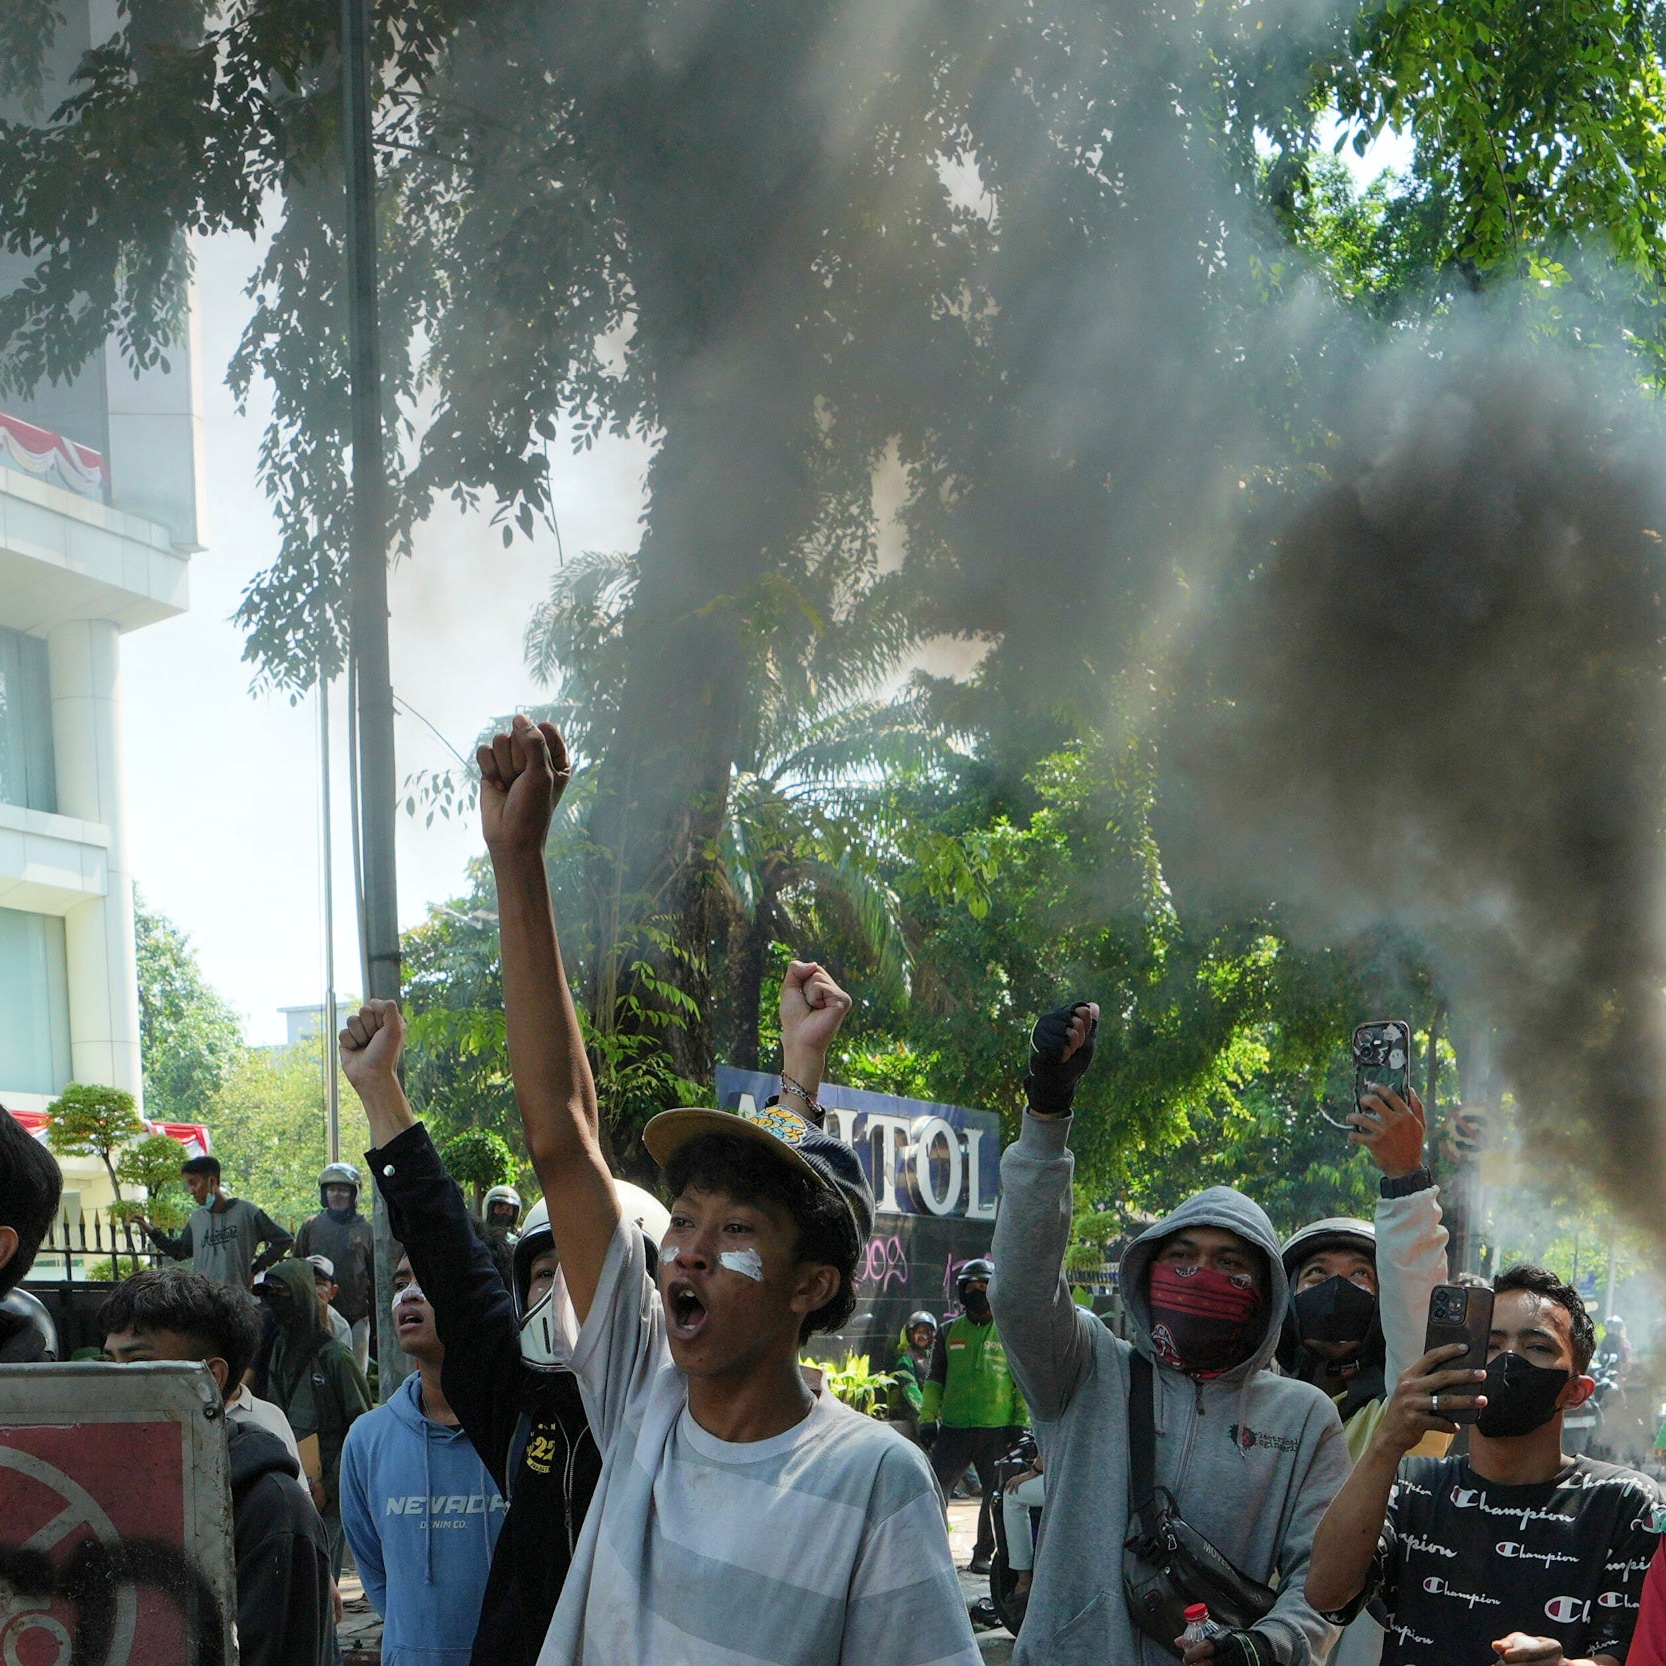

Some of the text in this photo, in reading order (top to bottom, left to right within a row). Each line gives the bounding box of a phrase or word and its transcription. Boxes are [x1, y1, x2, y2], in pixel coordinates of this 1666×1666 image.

[420, 1519, 452, 1530] DNIM
[1495, 1541, 1580, 1569] Champion
[1422, 1576, 1502, 1609] Champion
